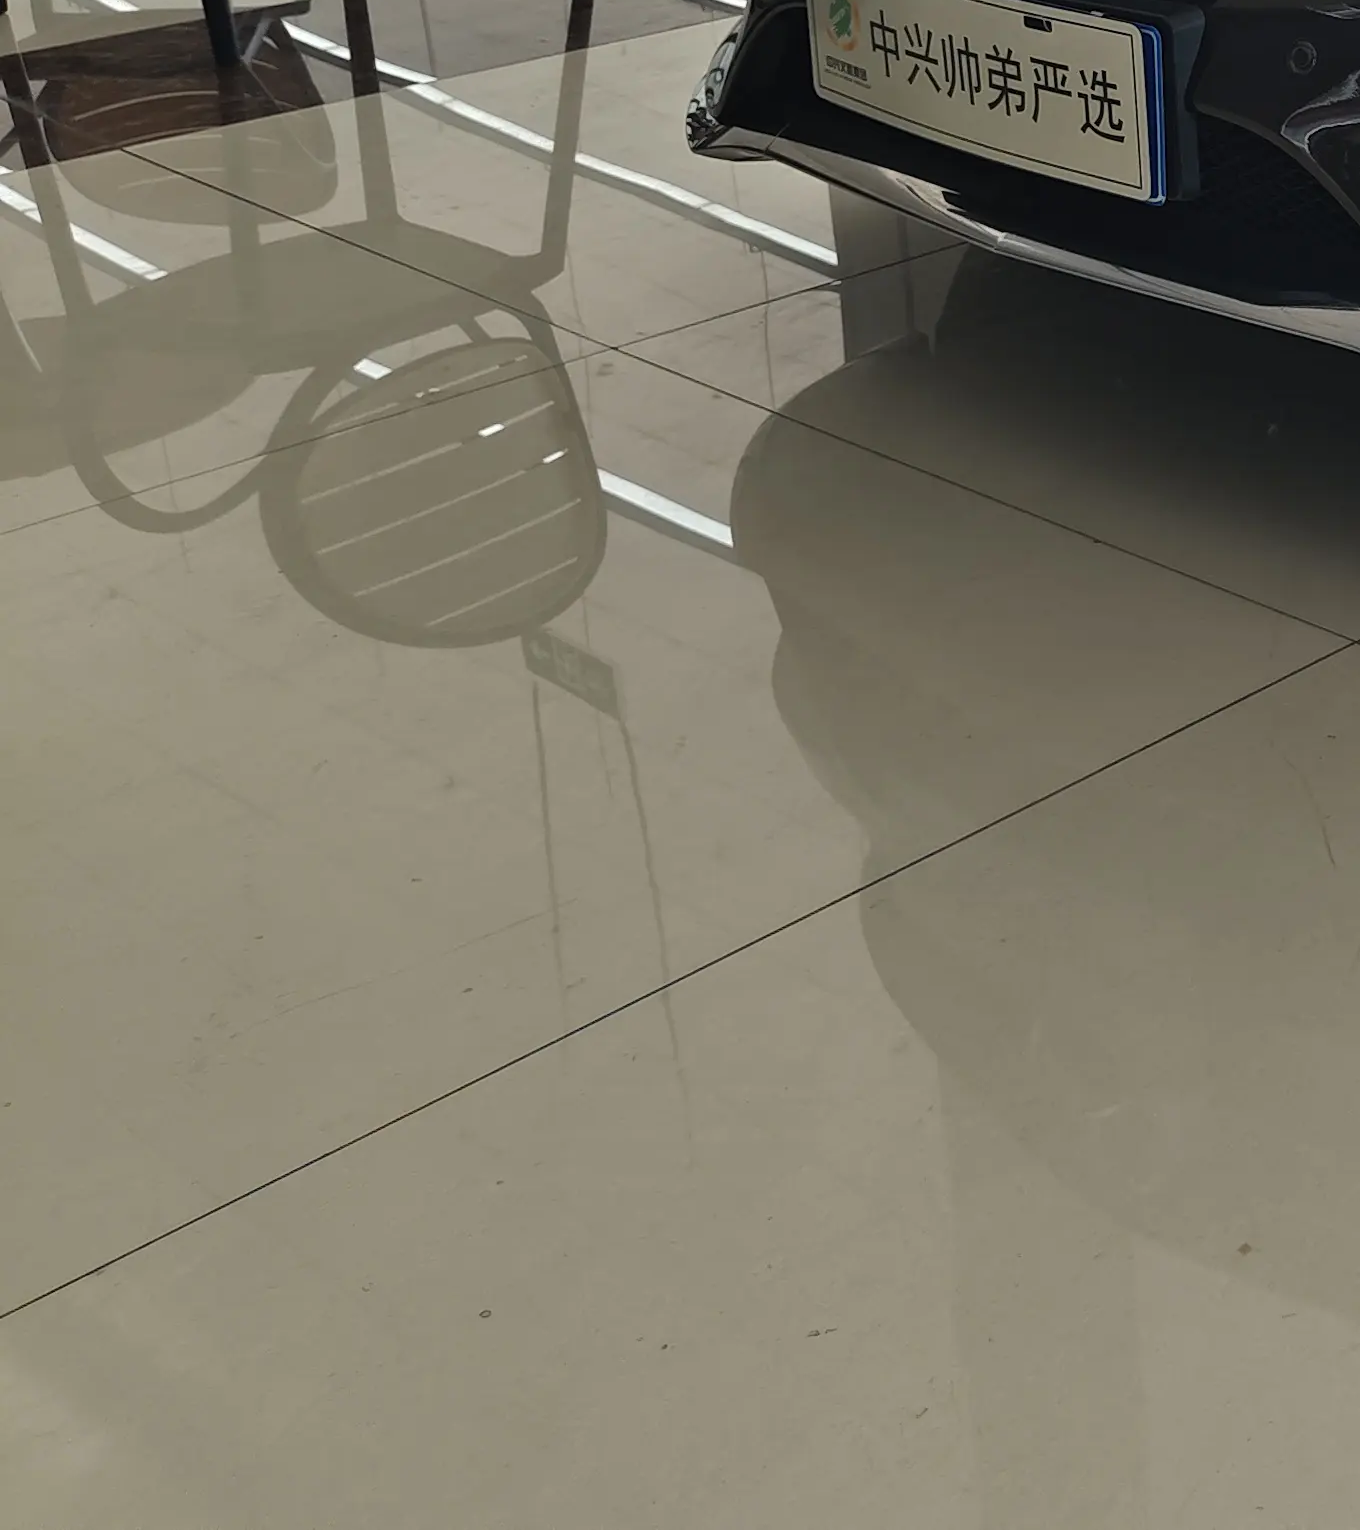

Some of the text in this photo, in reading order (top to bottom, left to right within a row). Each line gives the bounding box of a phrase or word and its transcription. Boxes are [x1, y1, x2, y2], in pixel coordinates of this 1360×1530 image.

[869, 9, 1125, 143] 中兴帅弟严选
